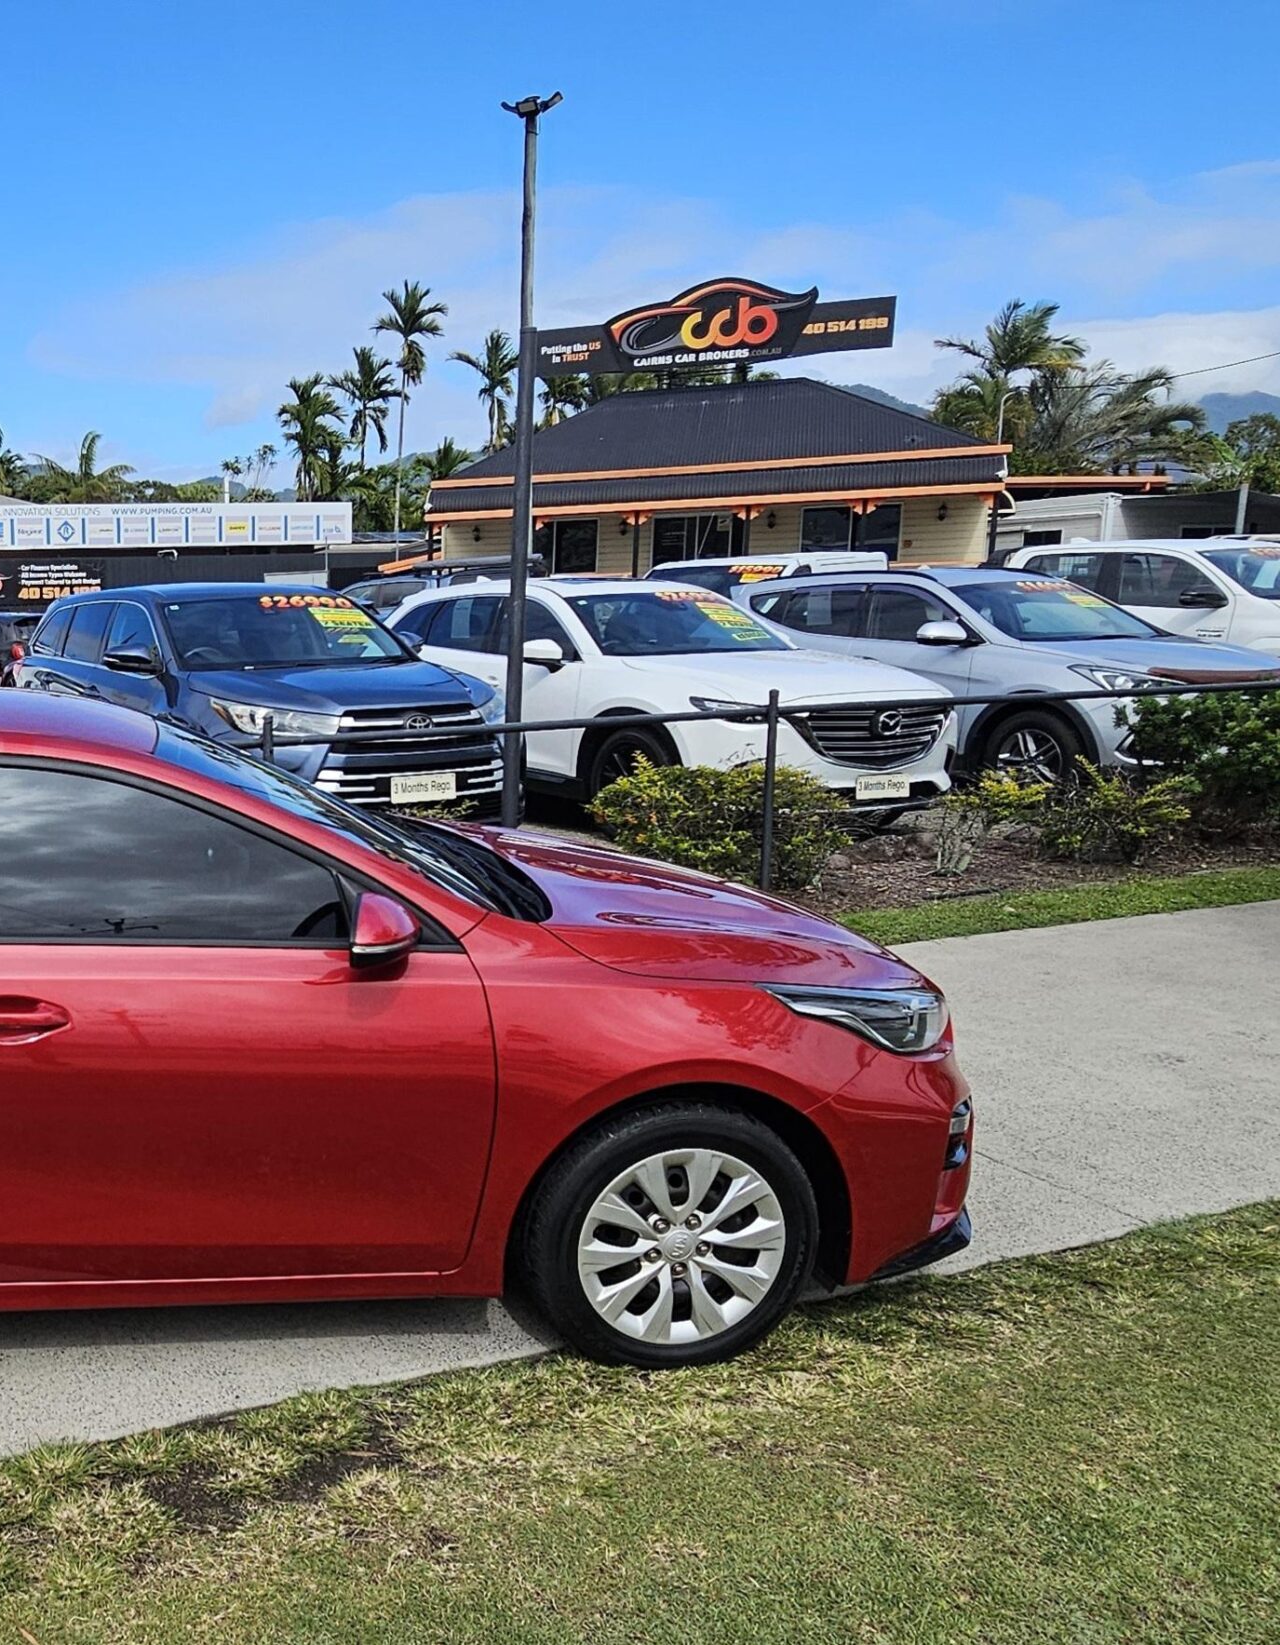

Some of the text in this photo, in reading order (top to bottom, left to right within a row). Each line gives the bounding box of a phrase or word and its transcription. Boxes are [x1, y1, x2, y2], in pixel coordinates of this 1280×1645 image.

[802, 322, 825, 334] 40
[827, 320, 856, 332] 514
[541, 341, 602, 356] Putting the US
[562, 352, 590, 362] TRUST
[633, 355, 673, 367] CAIRNS
[674, 353, 697, 363] CAR
[3, 507, 53, 516] INNOVATION
[55, 507, 101, 516] SOLUTIONS
[111, 506, 213, 515] WWW.PUMPING.COM.AU
[18, 586, 41, 599] 40
[42, 586, 71, 599] 514
[259, 595, 353, 609] $26990
[394, 783, 399, 794] 3
[401, 781, 429, 793] Months
[858, 781, 863, 792] 3
[864, 781, 886, 791] Months
